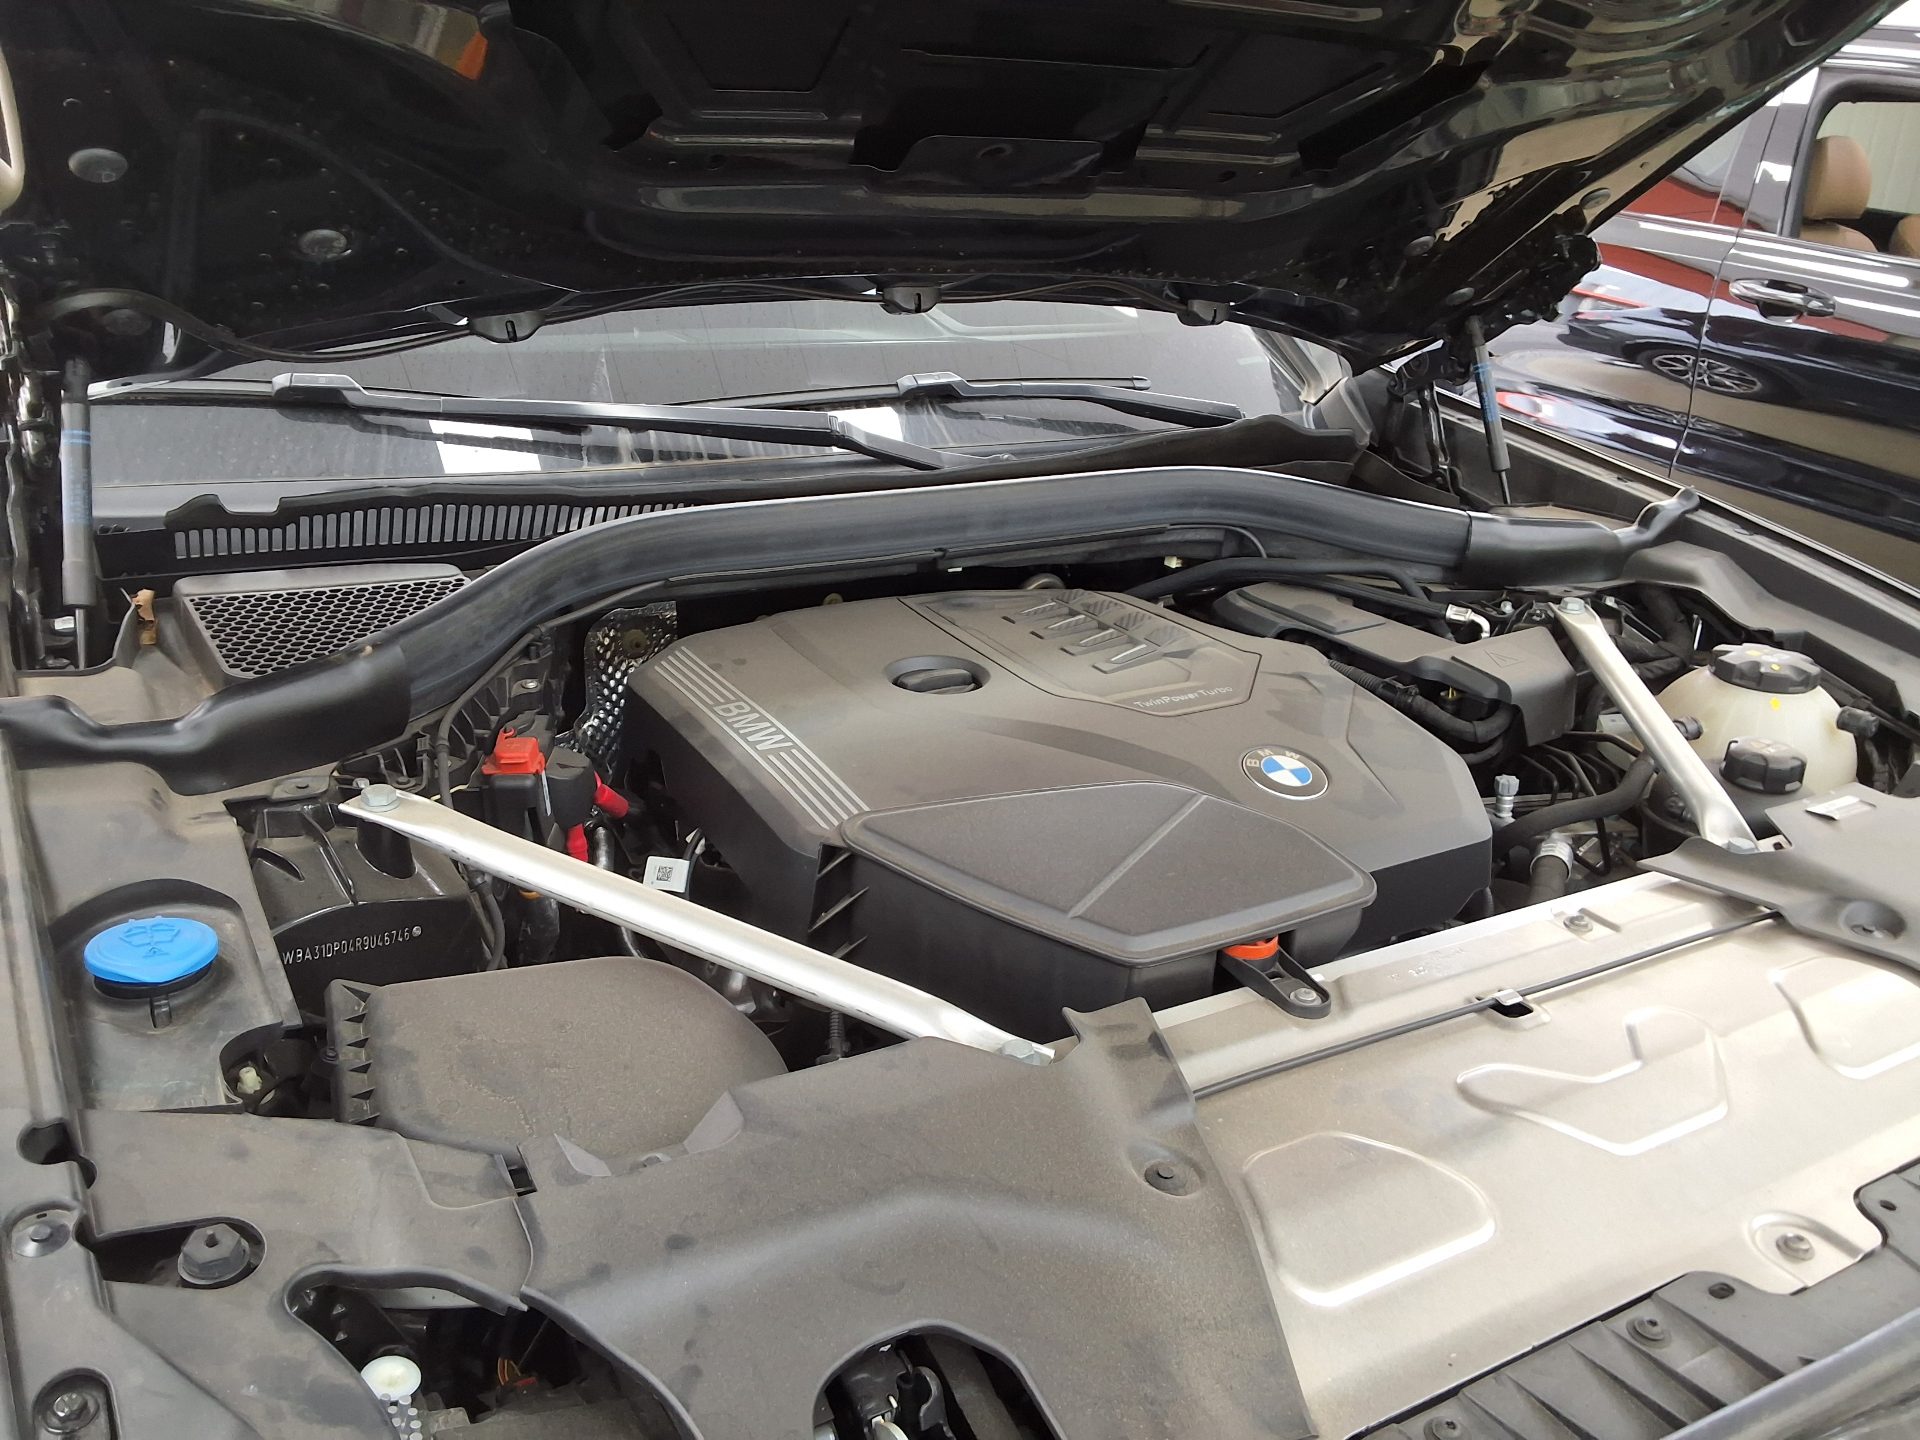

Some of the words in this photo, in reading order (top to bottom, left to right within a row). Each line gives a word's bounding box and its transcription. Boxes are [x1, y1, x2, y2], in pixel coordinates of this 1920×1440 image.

[1133, 692, 1199, 708] TwinPower
[1197, 686, 1233, 697] Turbo
[713, 701, 793, 751] BMW
[1246, 749, 1301, 768] BMW
